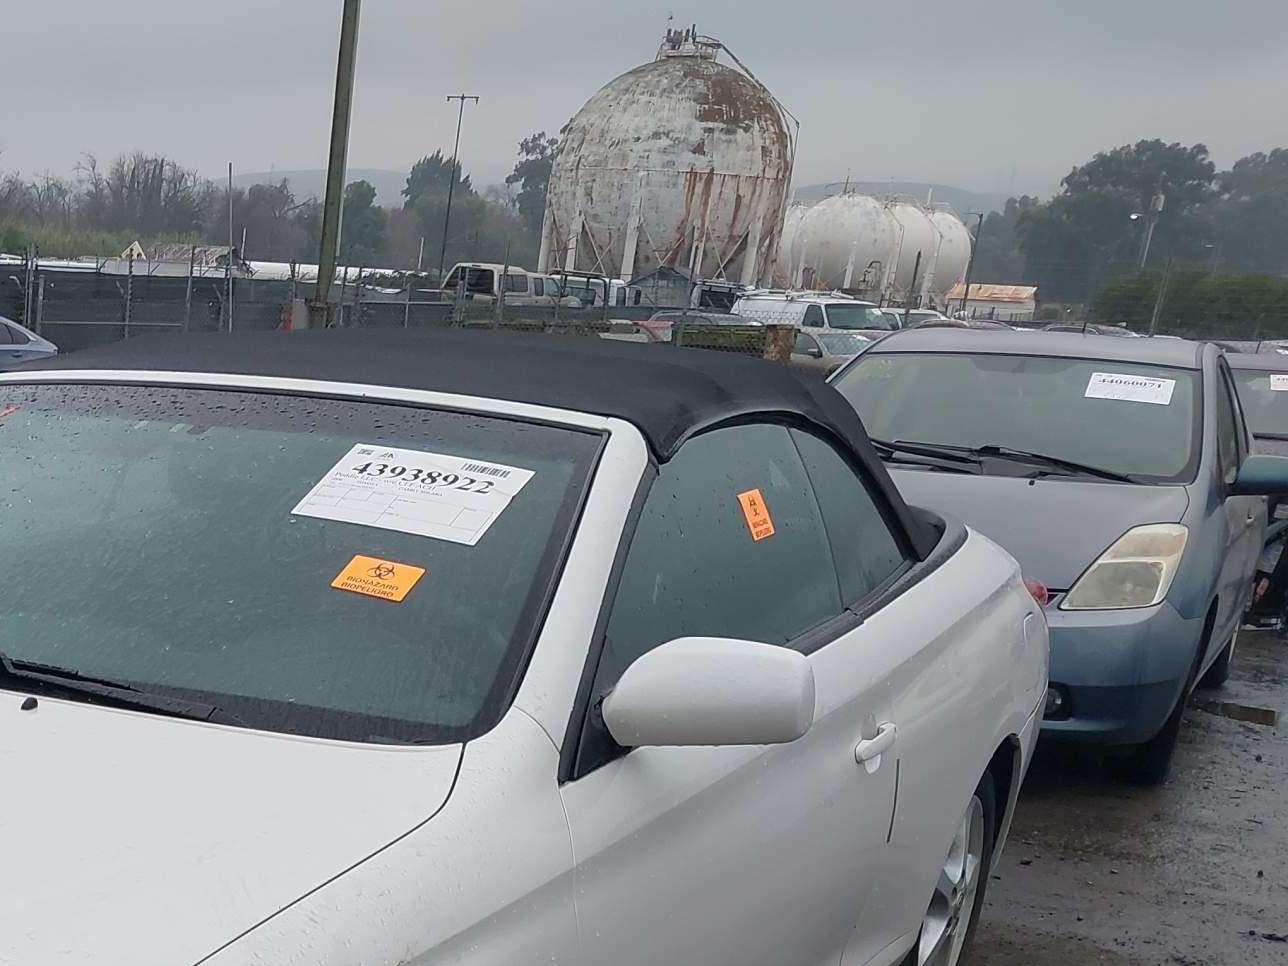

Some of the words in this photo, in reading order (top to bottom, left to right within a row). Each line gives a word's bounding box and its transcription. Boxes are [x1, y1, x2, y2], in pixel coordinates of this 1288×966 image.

[352, 461, 495, 494] 43938922
[340, 582, 394, 597] BIOPELIGRO
[346, 575, 399, 591] BIOHAZARD
